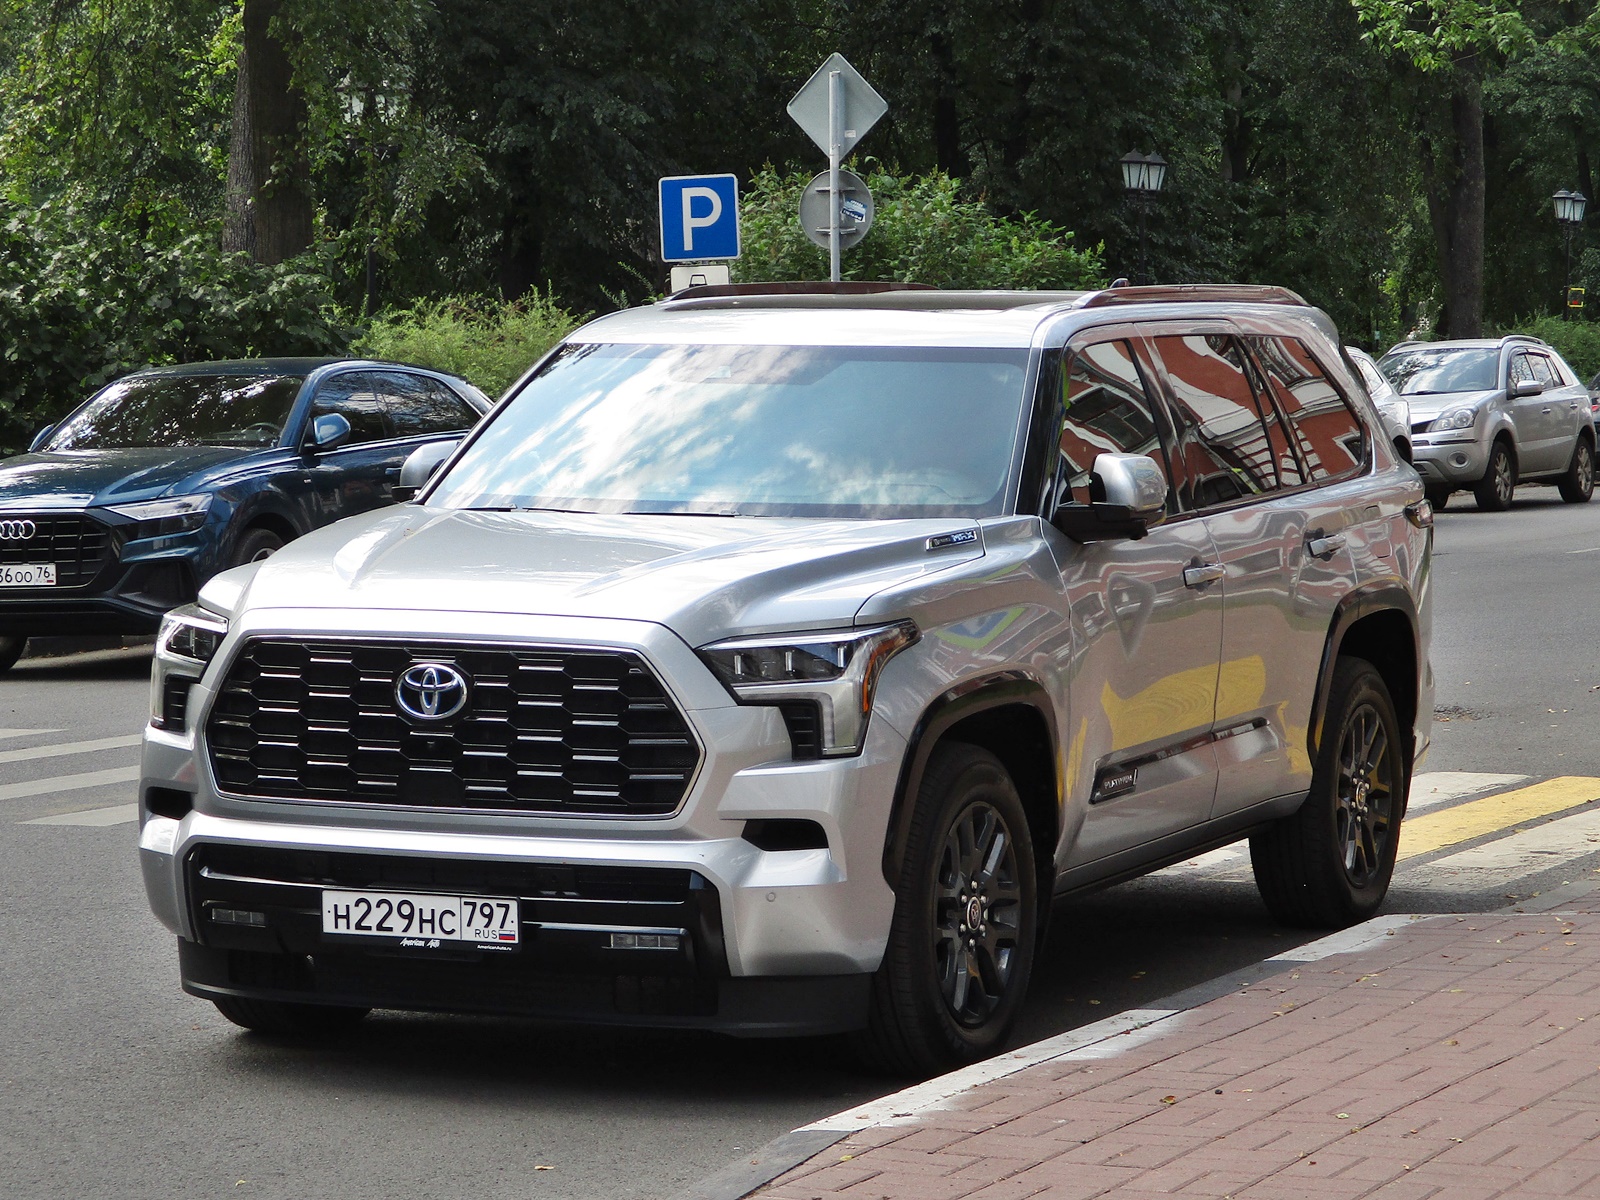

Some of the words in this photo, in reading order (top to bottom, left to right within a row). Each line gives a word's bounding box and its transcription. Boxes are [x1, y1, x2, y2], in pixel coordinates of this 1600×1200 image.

[681, 186, 722, 251] P
[36, 567, 51, 578] 76
[463, 901, 510, 929] 797
[474, 928, 498, 940] RUS
